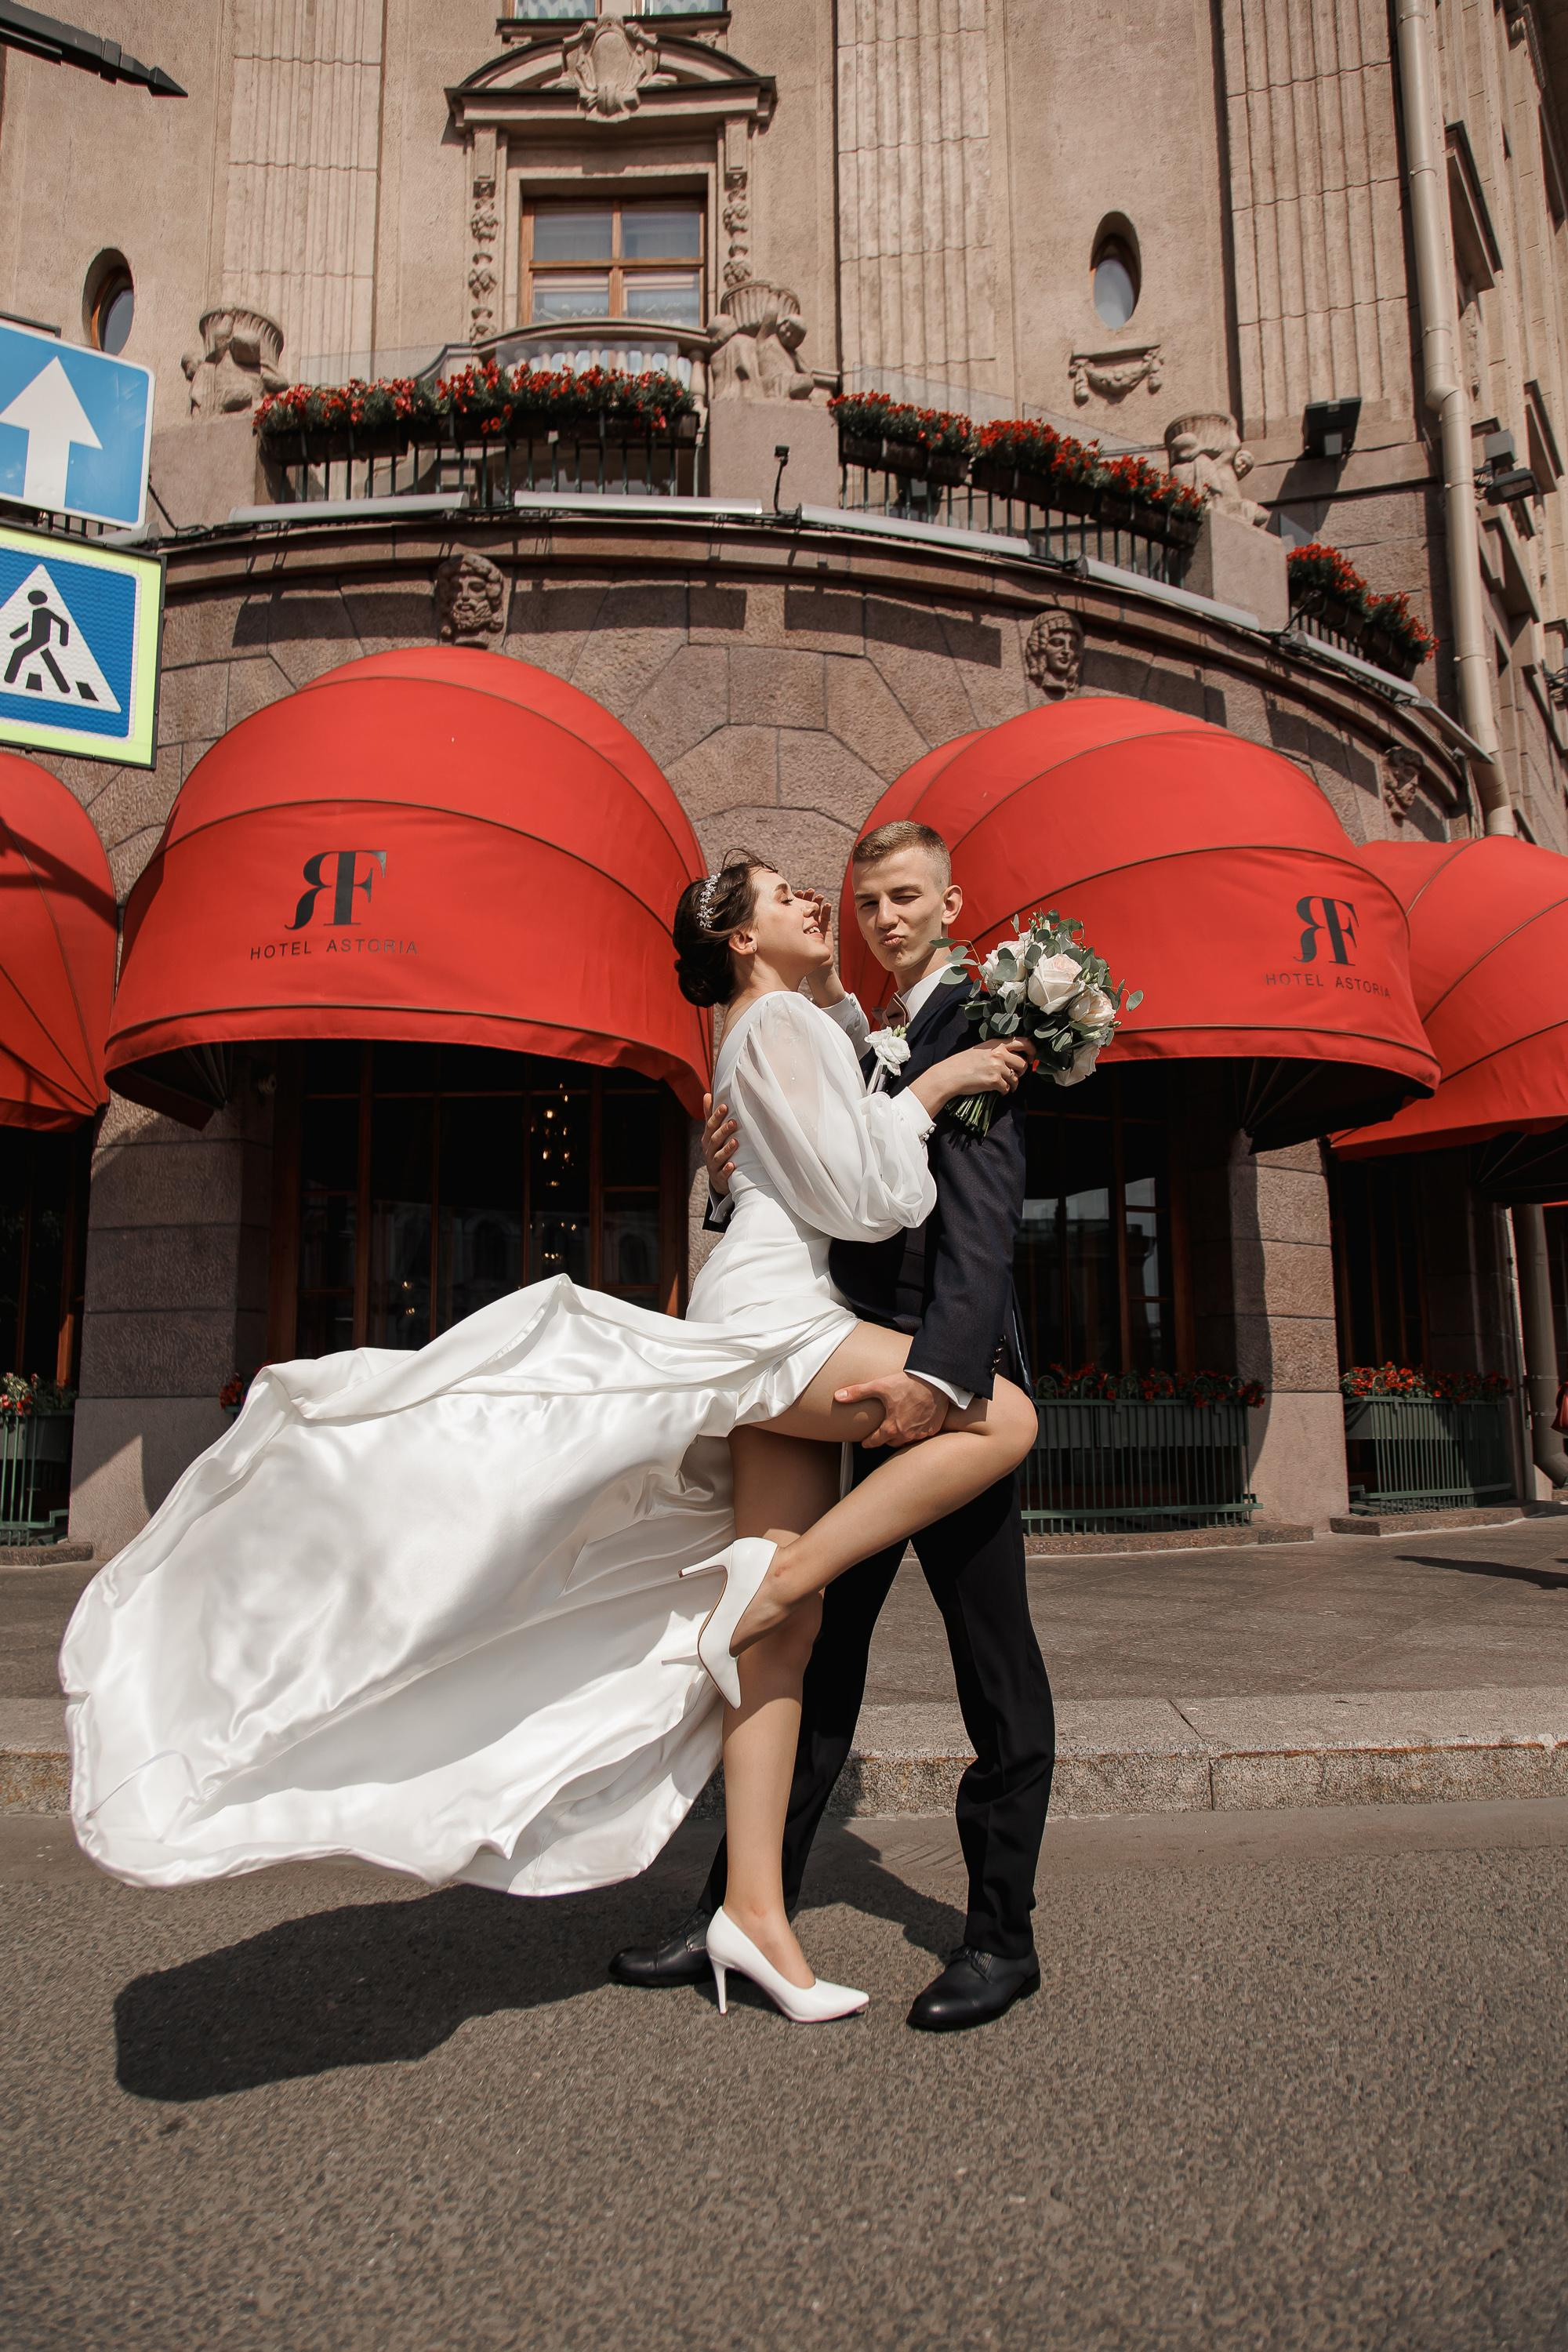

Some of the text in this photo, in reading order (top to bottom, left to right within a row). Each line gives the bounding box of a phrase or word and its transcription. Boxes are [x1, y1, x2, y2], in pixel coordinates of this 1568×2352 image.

[249, 938, 418, 960] HOTEL ASTORIA
[1265, 973, 1391, 998] HOTEL ASTORIA
